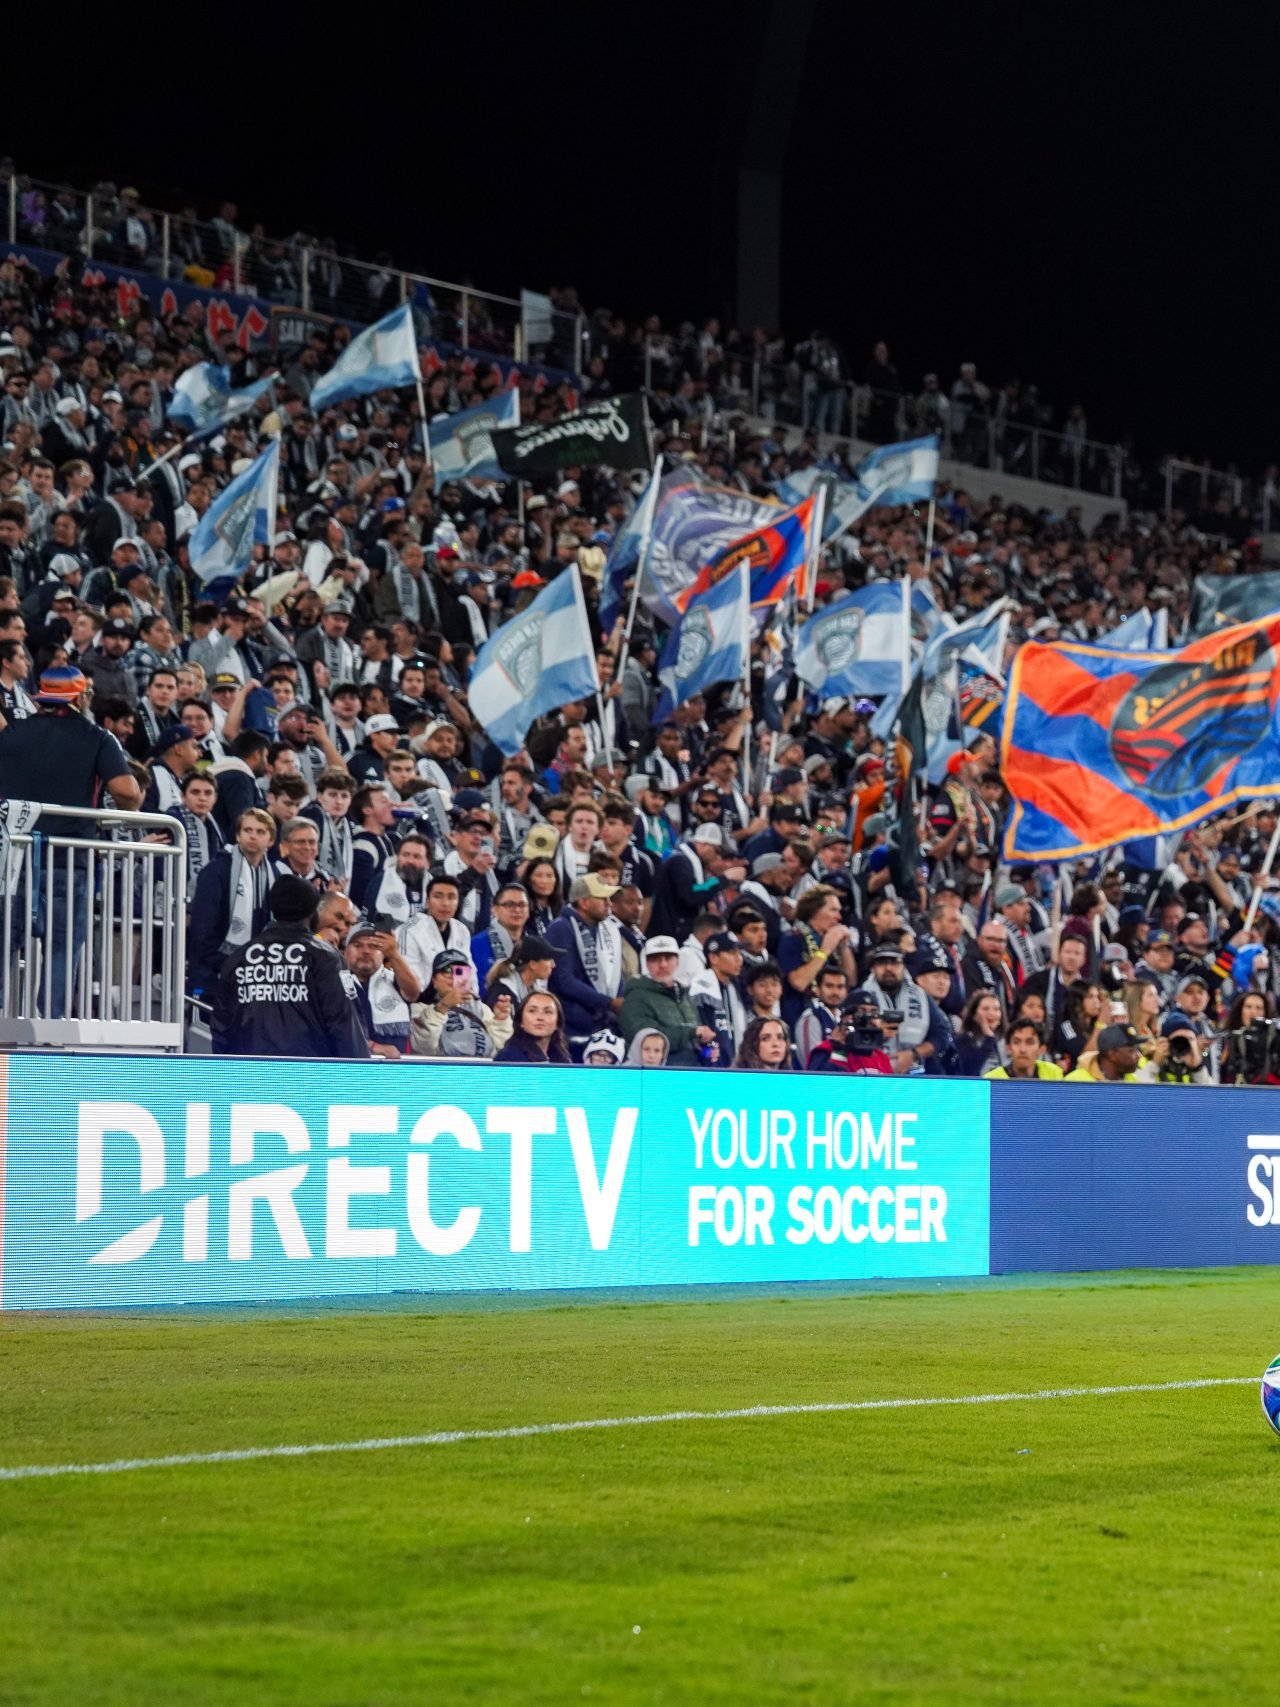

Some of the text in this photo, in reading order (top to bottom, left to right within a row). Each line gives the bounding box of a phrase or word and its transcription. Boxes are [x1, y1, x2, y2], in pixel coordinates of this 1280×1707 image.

[245, 943, 307, 964] CSC
[235, 965, 309, 984] SECURITY
[238, 984, 309, 1004] SUPERVISOR
[686, 1107, 918, 1170] YOUR HOME
[75, 1100, 639, 1265] DIRECTV
[688, 1185, 948, 1246] FOR SOCCER
